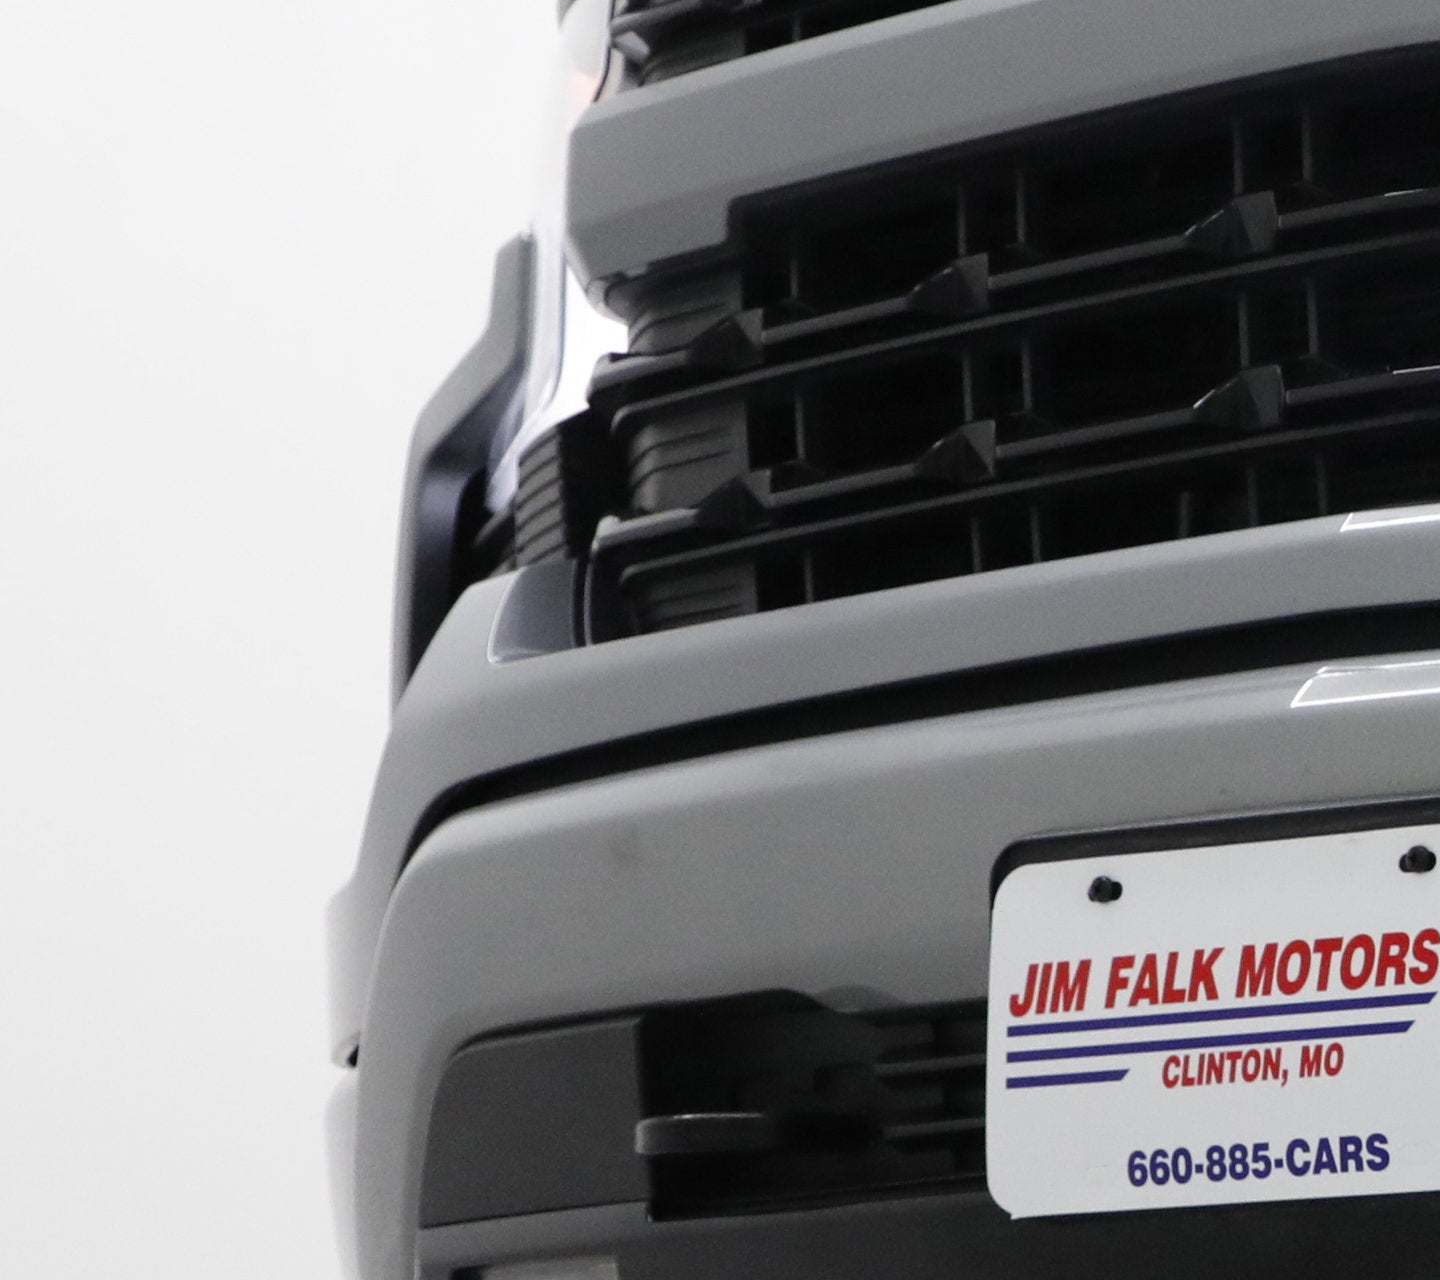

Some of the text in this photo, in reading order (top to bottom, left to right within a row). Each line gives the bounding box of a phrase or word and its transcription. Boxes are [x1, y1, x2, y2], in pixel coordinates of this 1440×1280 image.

[1009, 928, 1440, 1018] JIM FALK MOTORS
[1161, 1043, 1344, 1088] CLINTON, MO
[1127, 1133, 1390, 1187] 660-885-CARS
